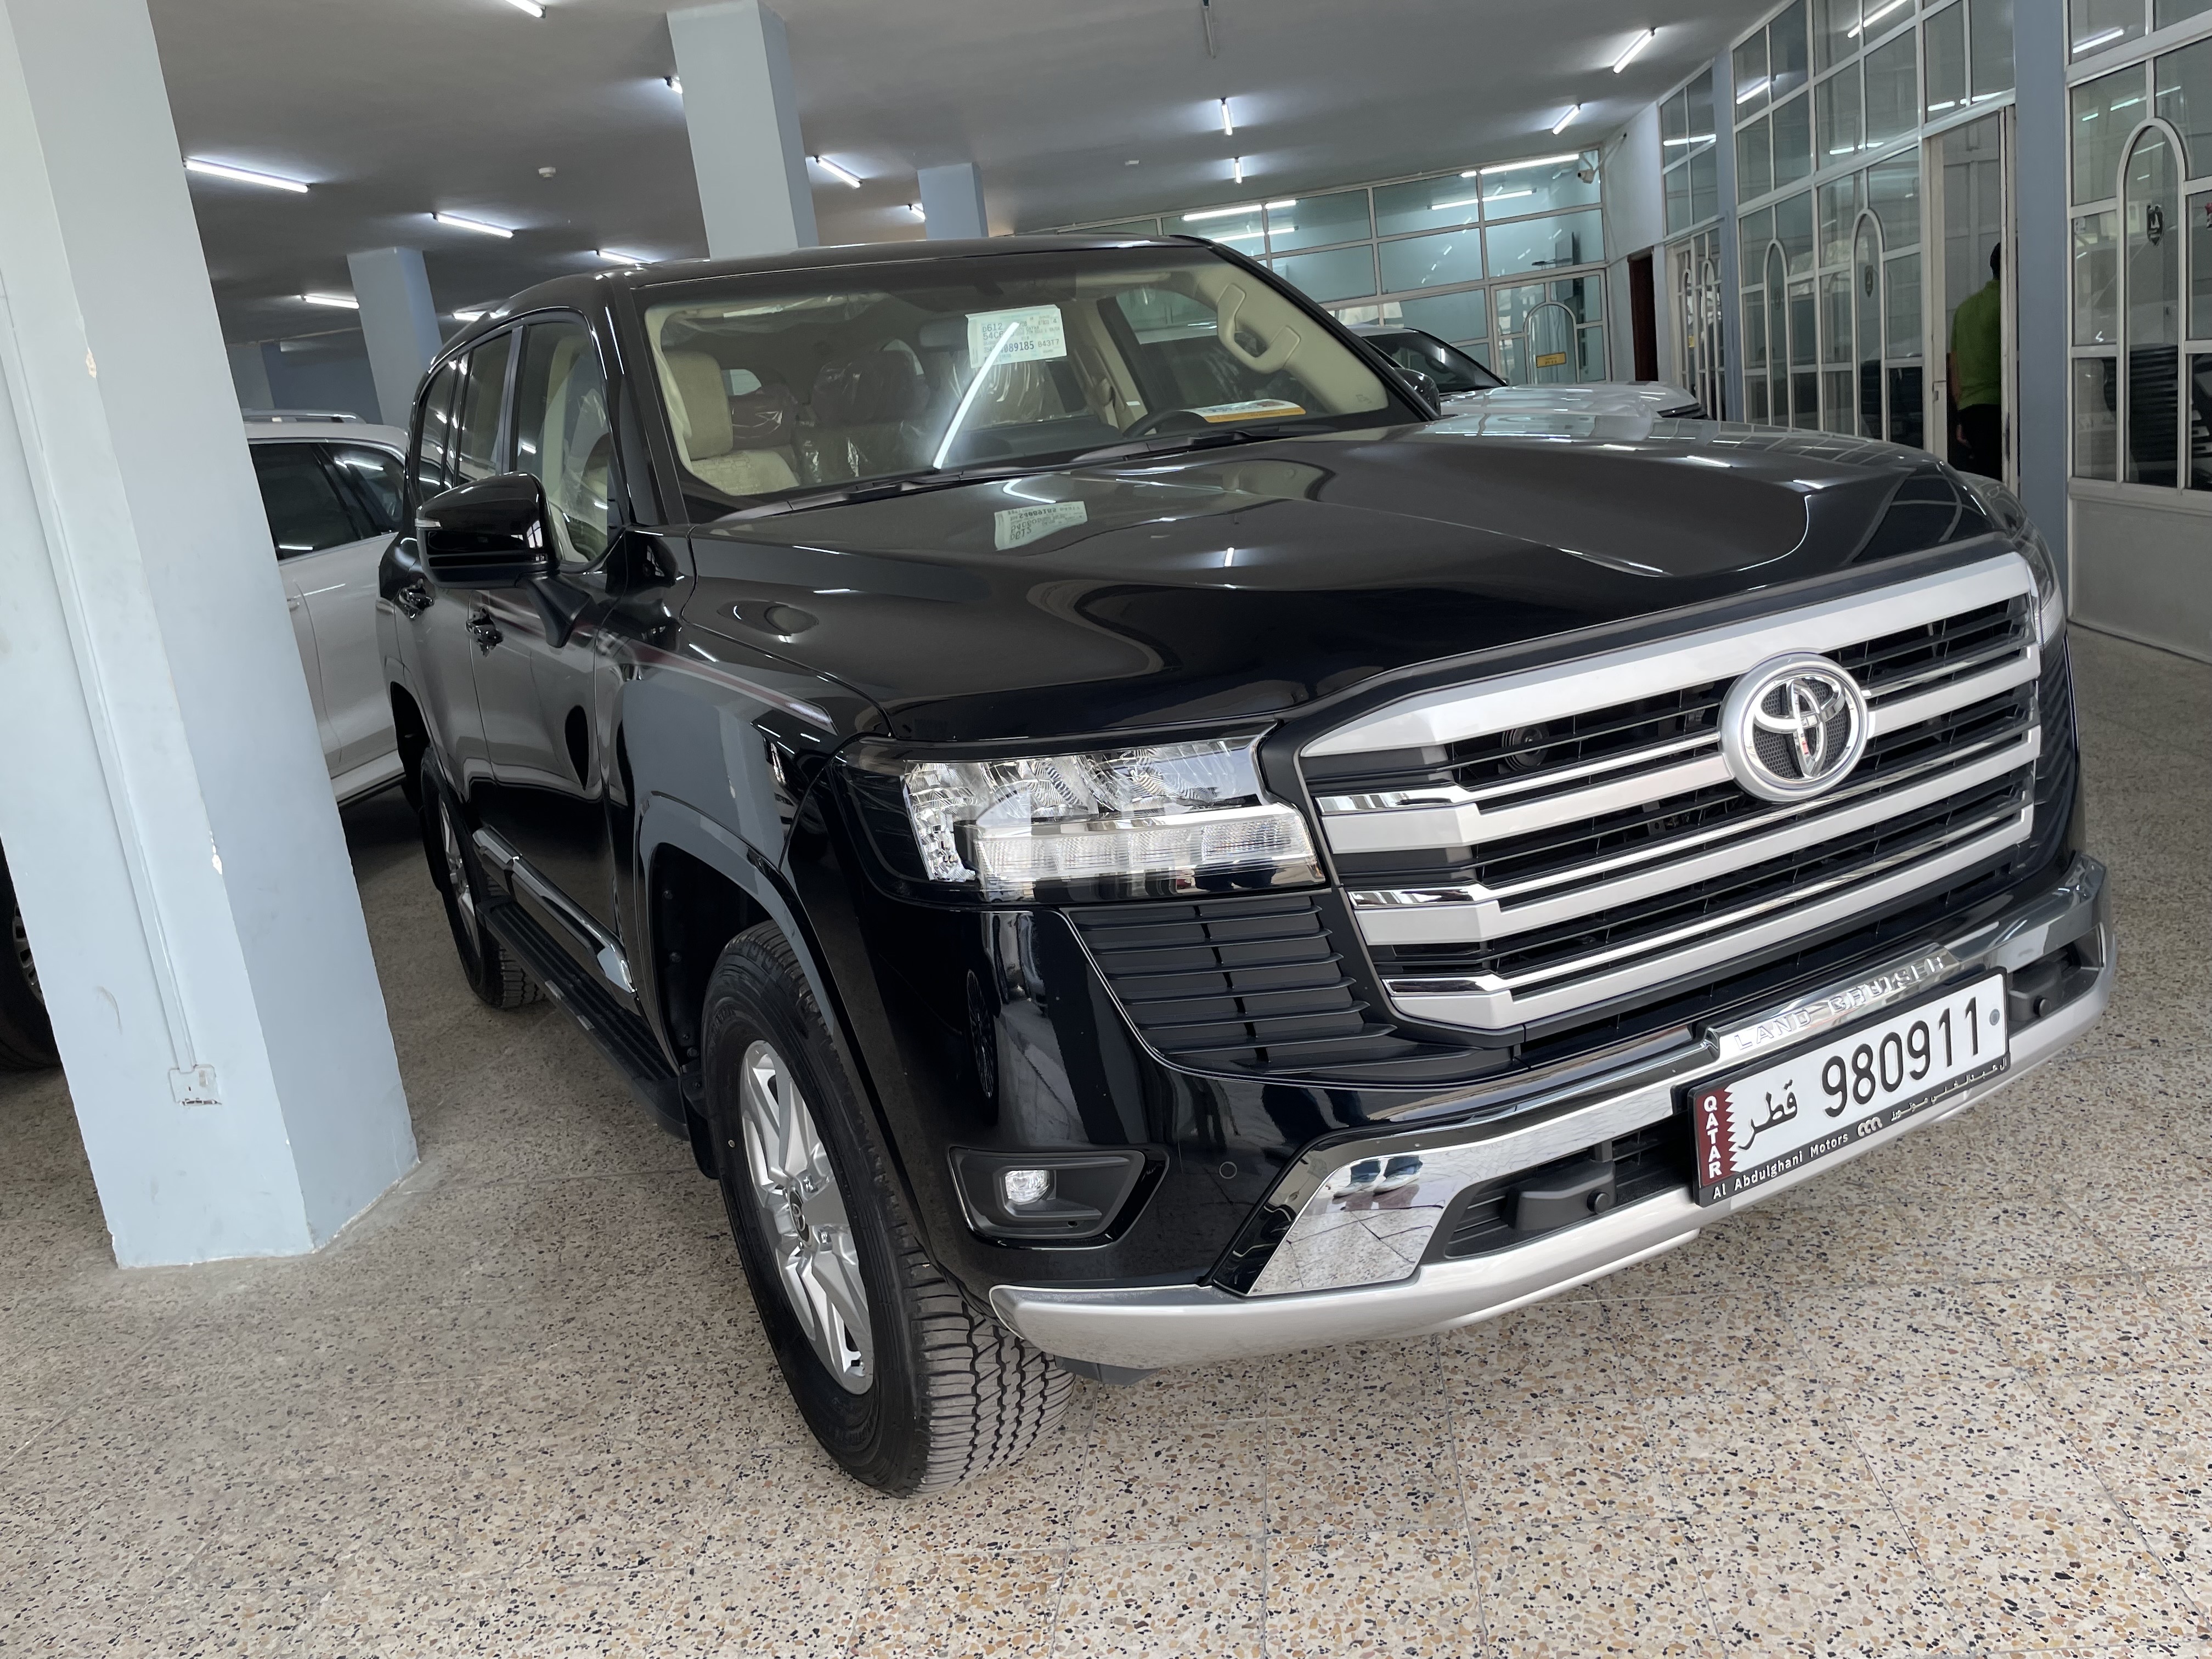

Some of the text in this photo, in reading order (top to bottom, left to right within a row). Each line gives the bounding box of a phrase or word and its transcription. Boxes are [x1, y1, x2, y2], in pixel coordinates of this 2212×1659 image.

[1734, 955, 1944, 1051] LAND CRUISER
[1821, 996, 1979, 1118] 980911
[1703, 1096, 1722, 1179] QATAR
[1737, 1079, 1798, 1150] قطر
[1712, 1132, 1849, 1200] Al Abdulghani Motors
